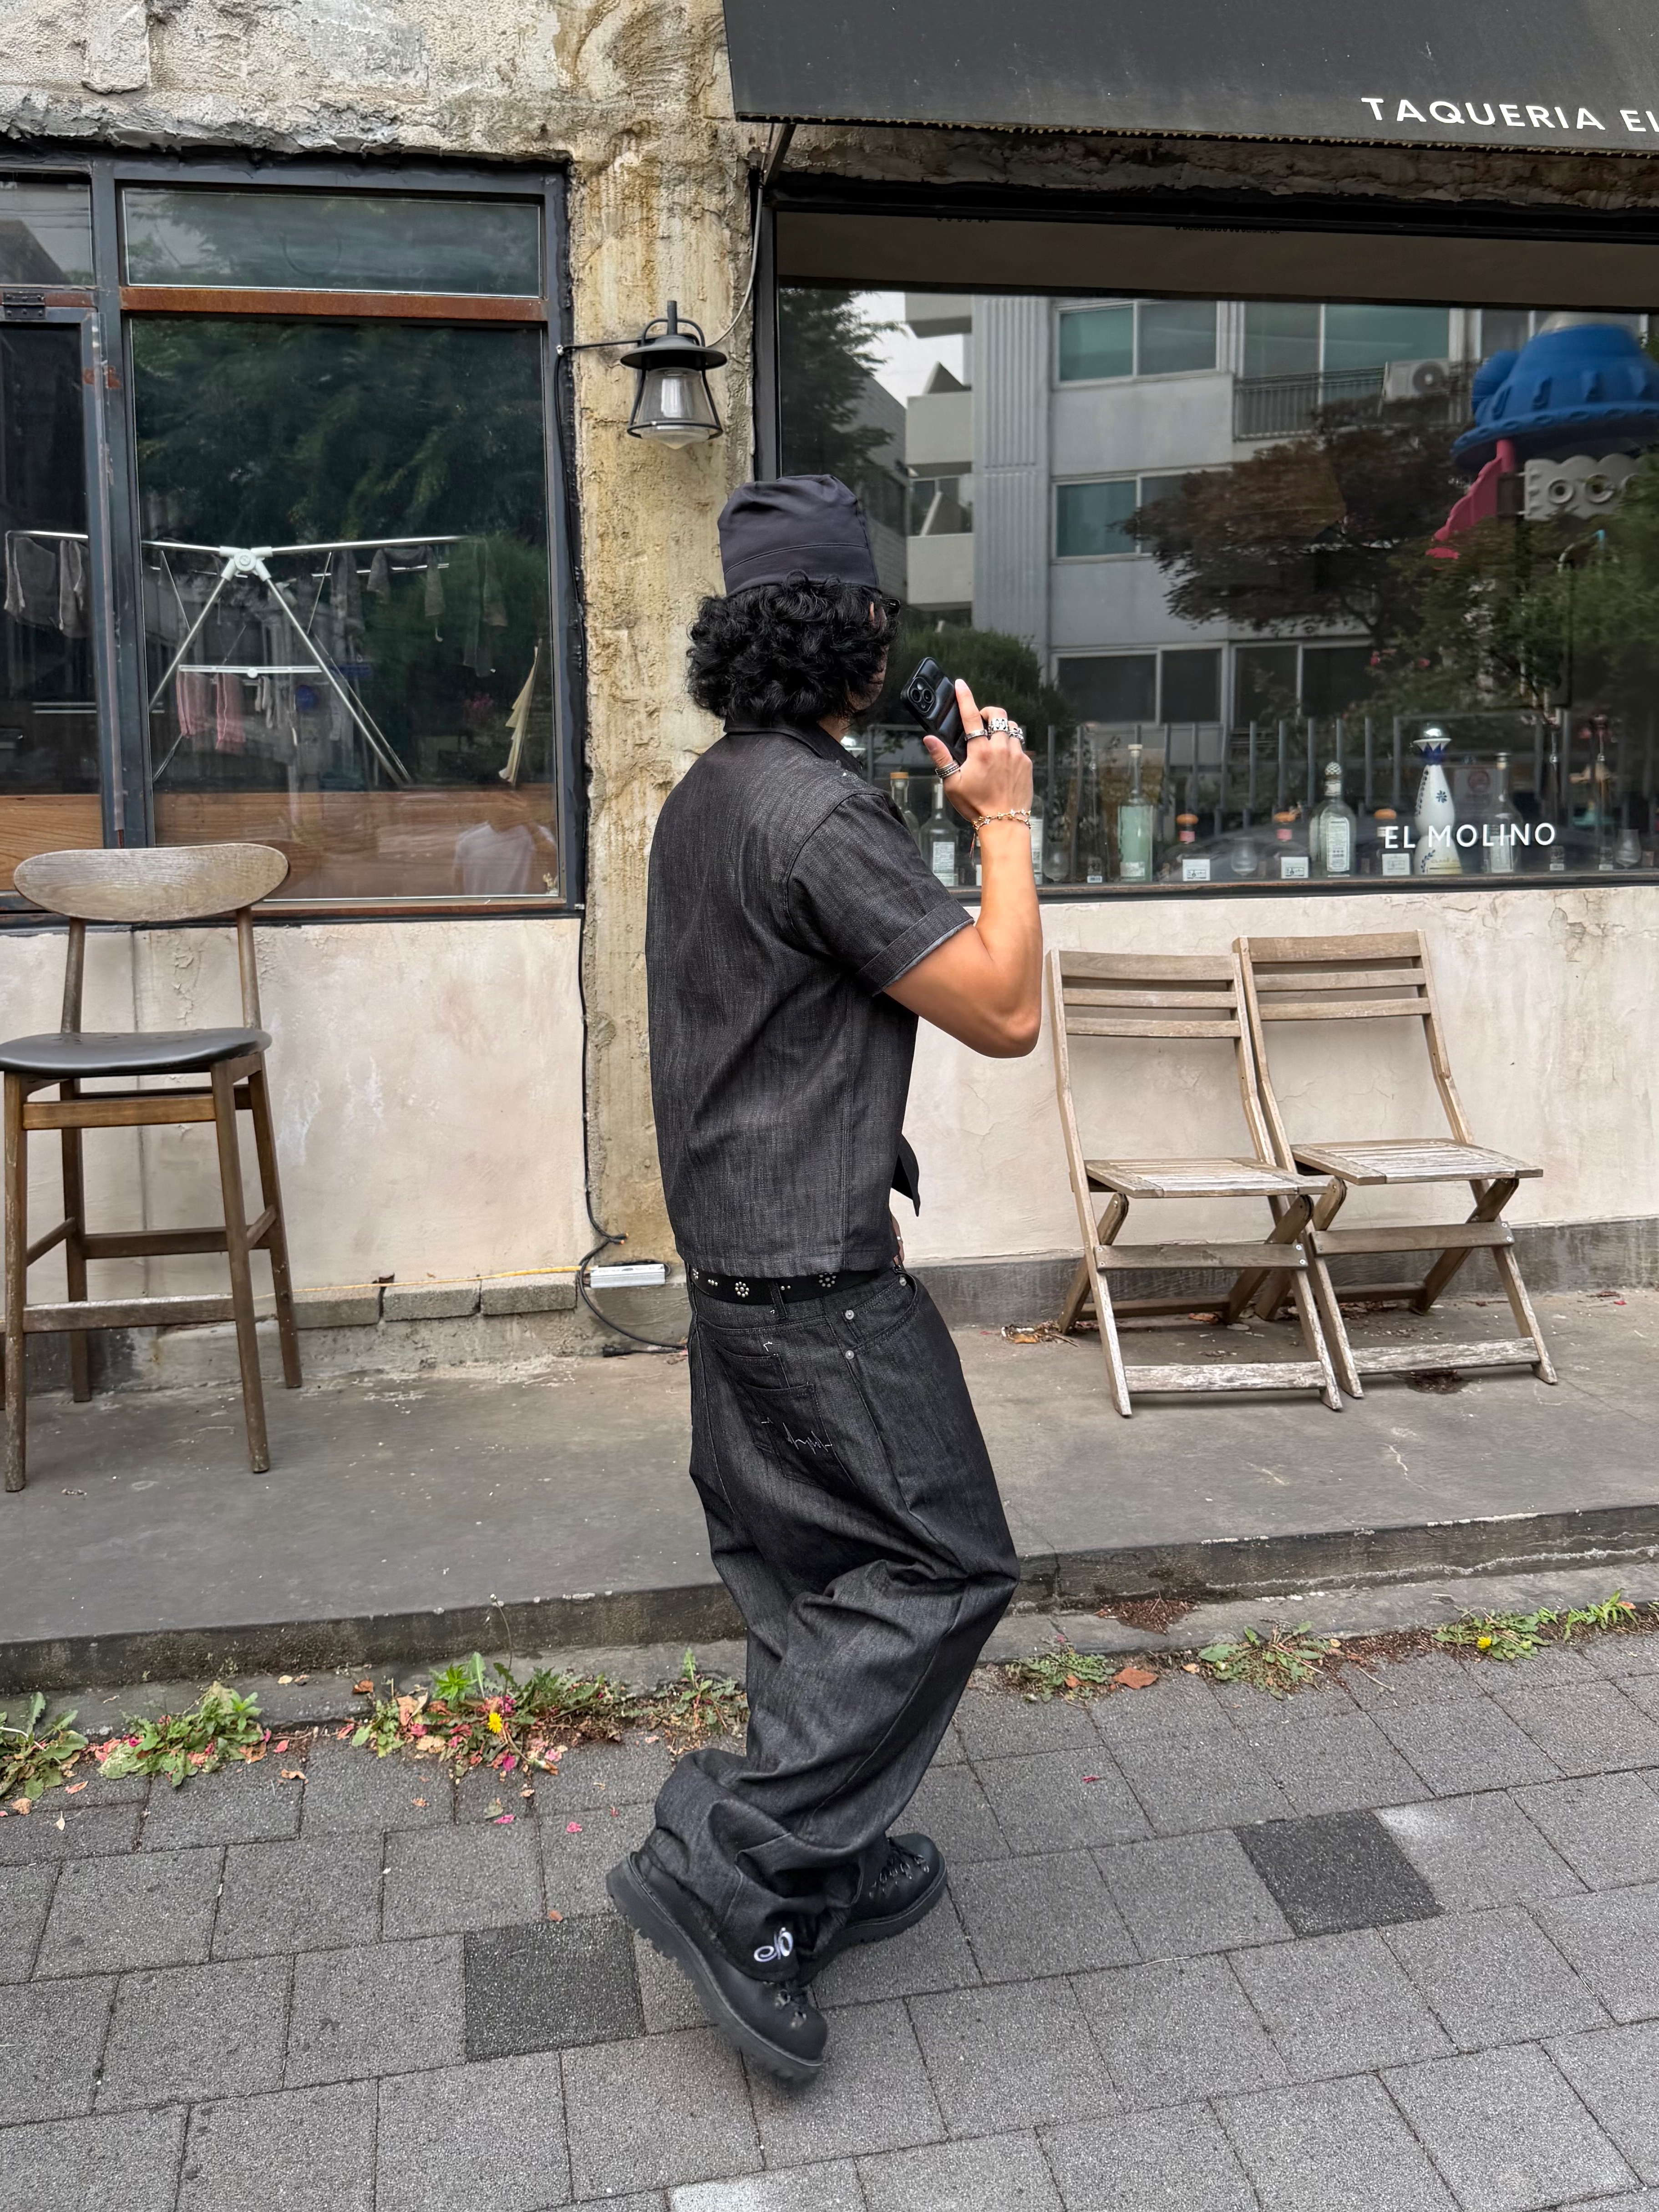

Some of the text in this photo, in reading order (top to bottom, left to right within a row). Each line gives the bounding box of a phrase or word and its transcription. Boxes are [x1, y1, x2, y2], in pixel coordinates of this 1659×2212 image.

[1361, 97, 1606, 130] TAQUERIA
[1385, 823, 1556, 849] EL MOLINO
